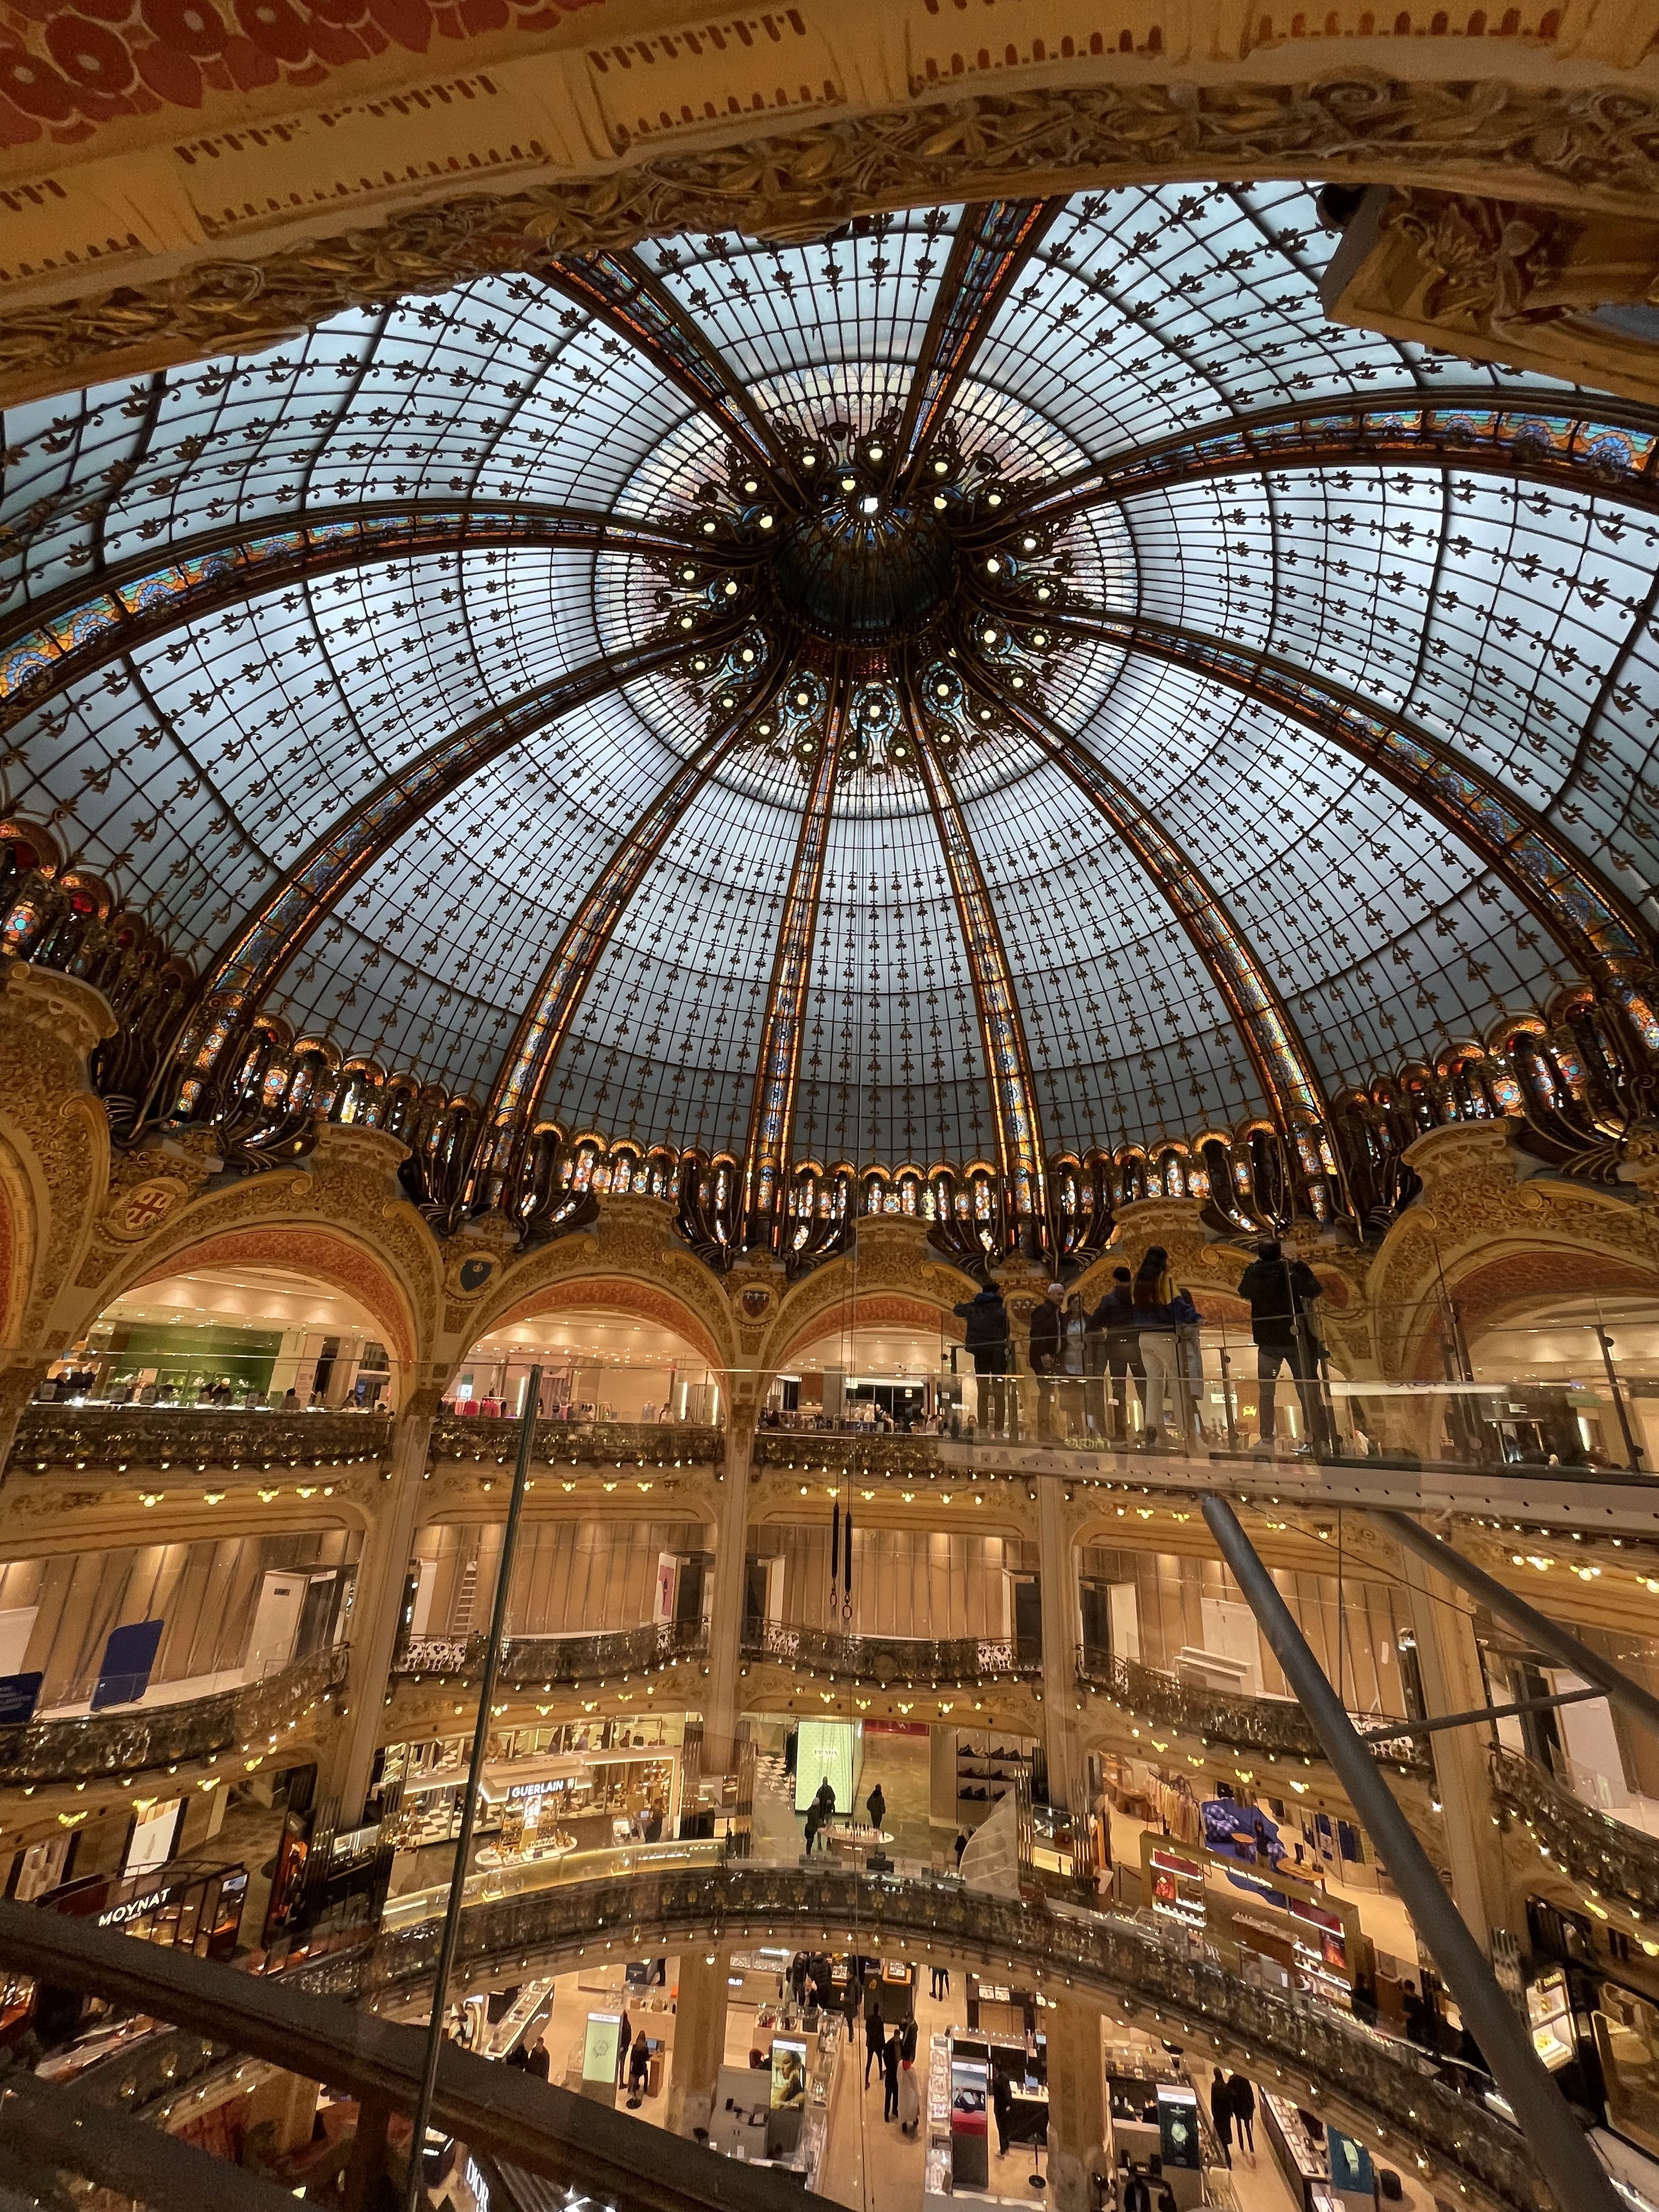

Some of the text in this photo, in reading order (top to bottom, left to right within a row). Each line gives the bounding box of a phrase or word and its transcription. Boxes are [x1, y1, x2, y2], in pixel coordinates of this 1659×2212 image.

[511, 1780, 564, 1798] GUERLAIN
[98, 1887, 171, 1927] MOYNAT
[466, 2155, 489, 2212] DIOR
